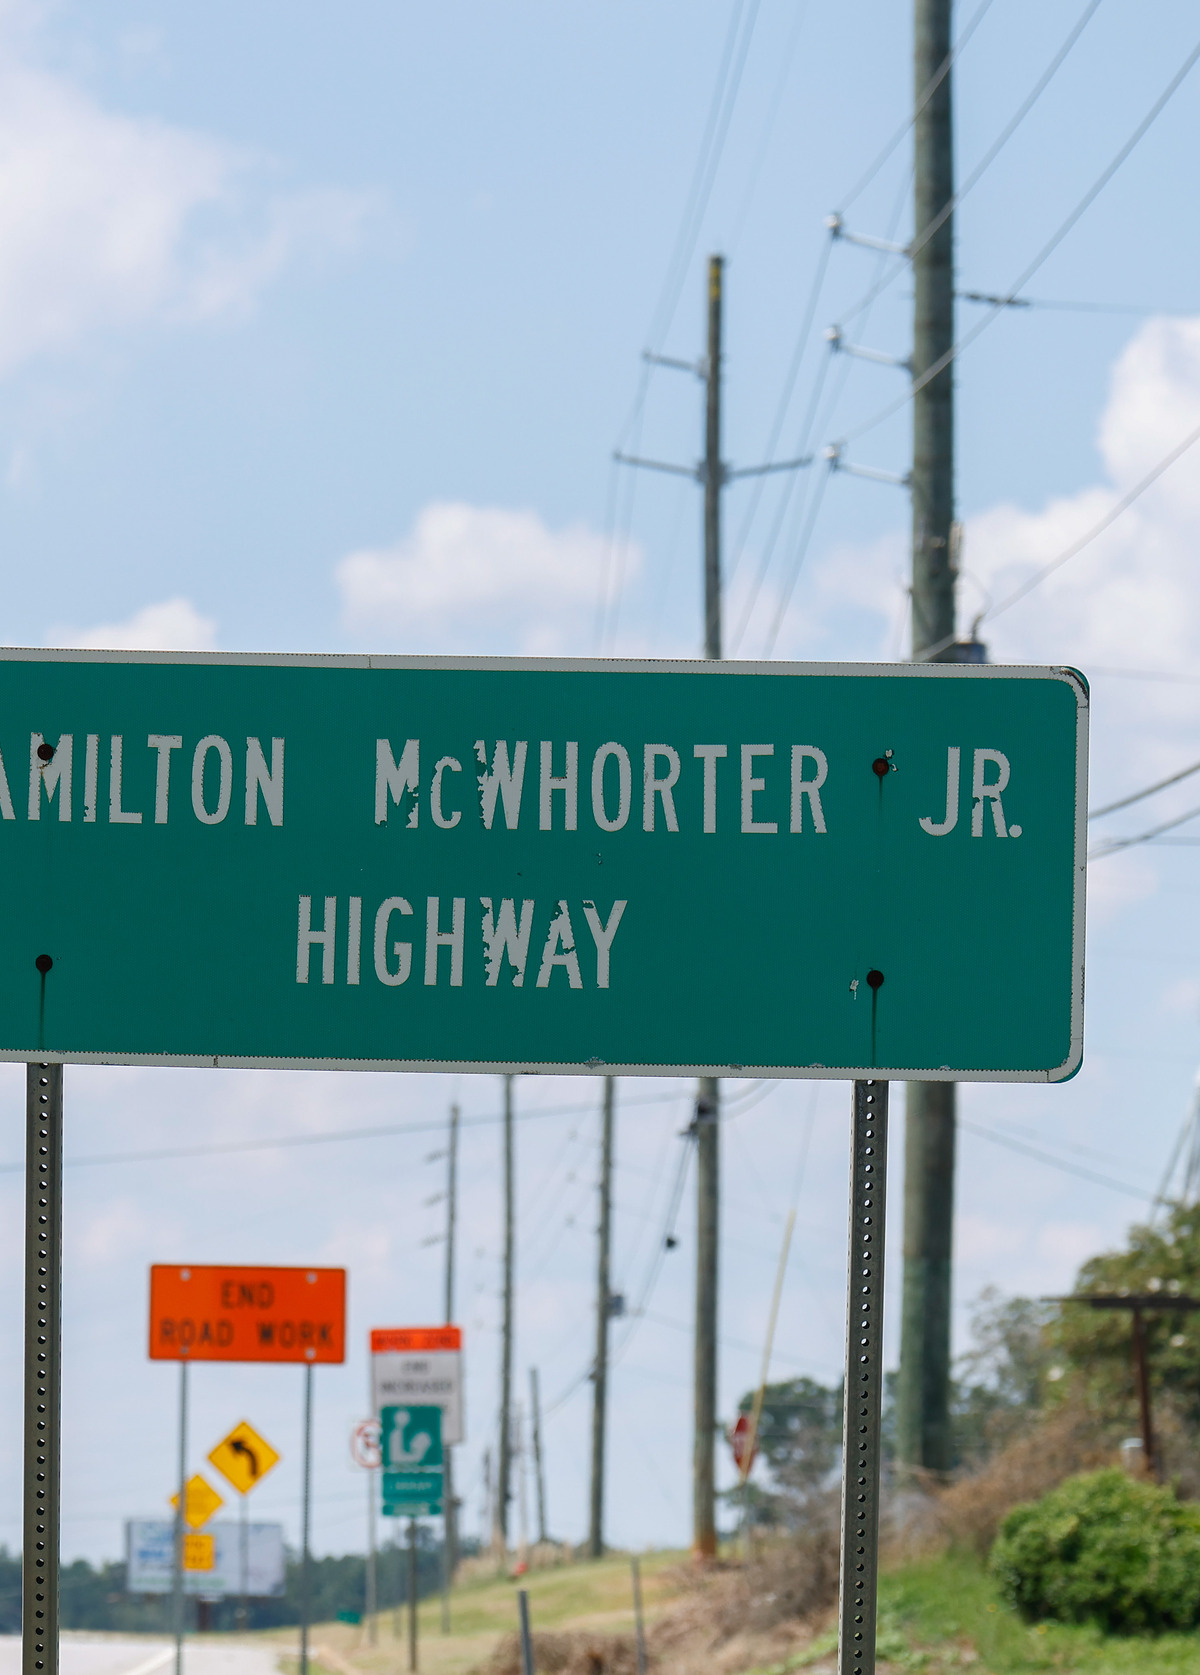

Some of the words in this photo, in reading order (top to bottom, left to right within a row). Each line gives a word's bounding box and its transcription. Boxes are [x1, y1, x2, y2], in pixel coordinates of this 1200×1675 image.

[375, 739, 829, 834] McWHORTER
[919, 747, 1023, 838] JR.
[297, 895, 628, 989] HIGHWAY
[221, 1280, 275, 1309] END
[160, 1318, 234, 1347] ROAD
[256, 1320, 334, 1349] WORK
